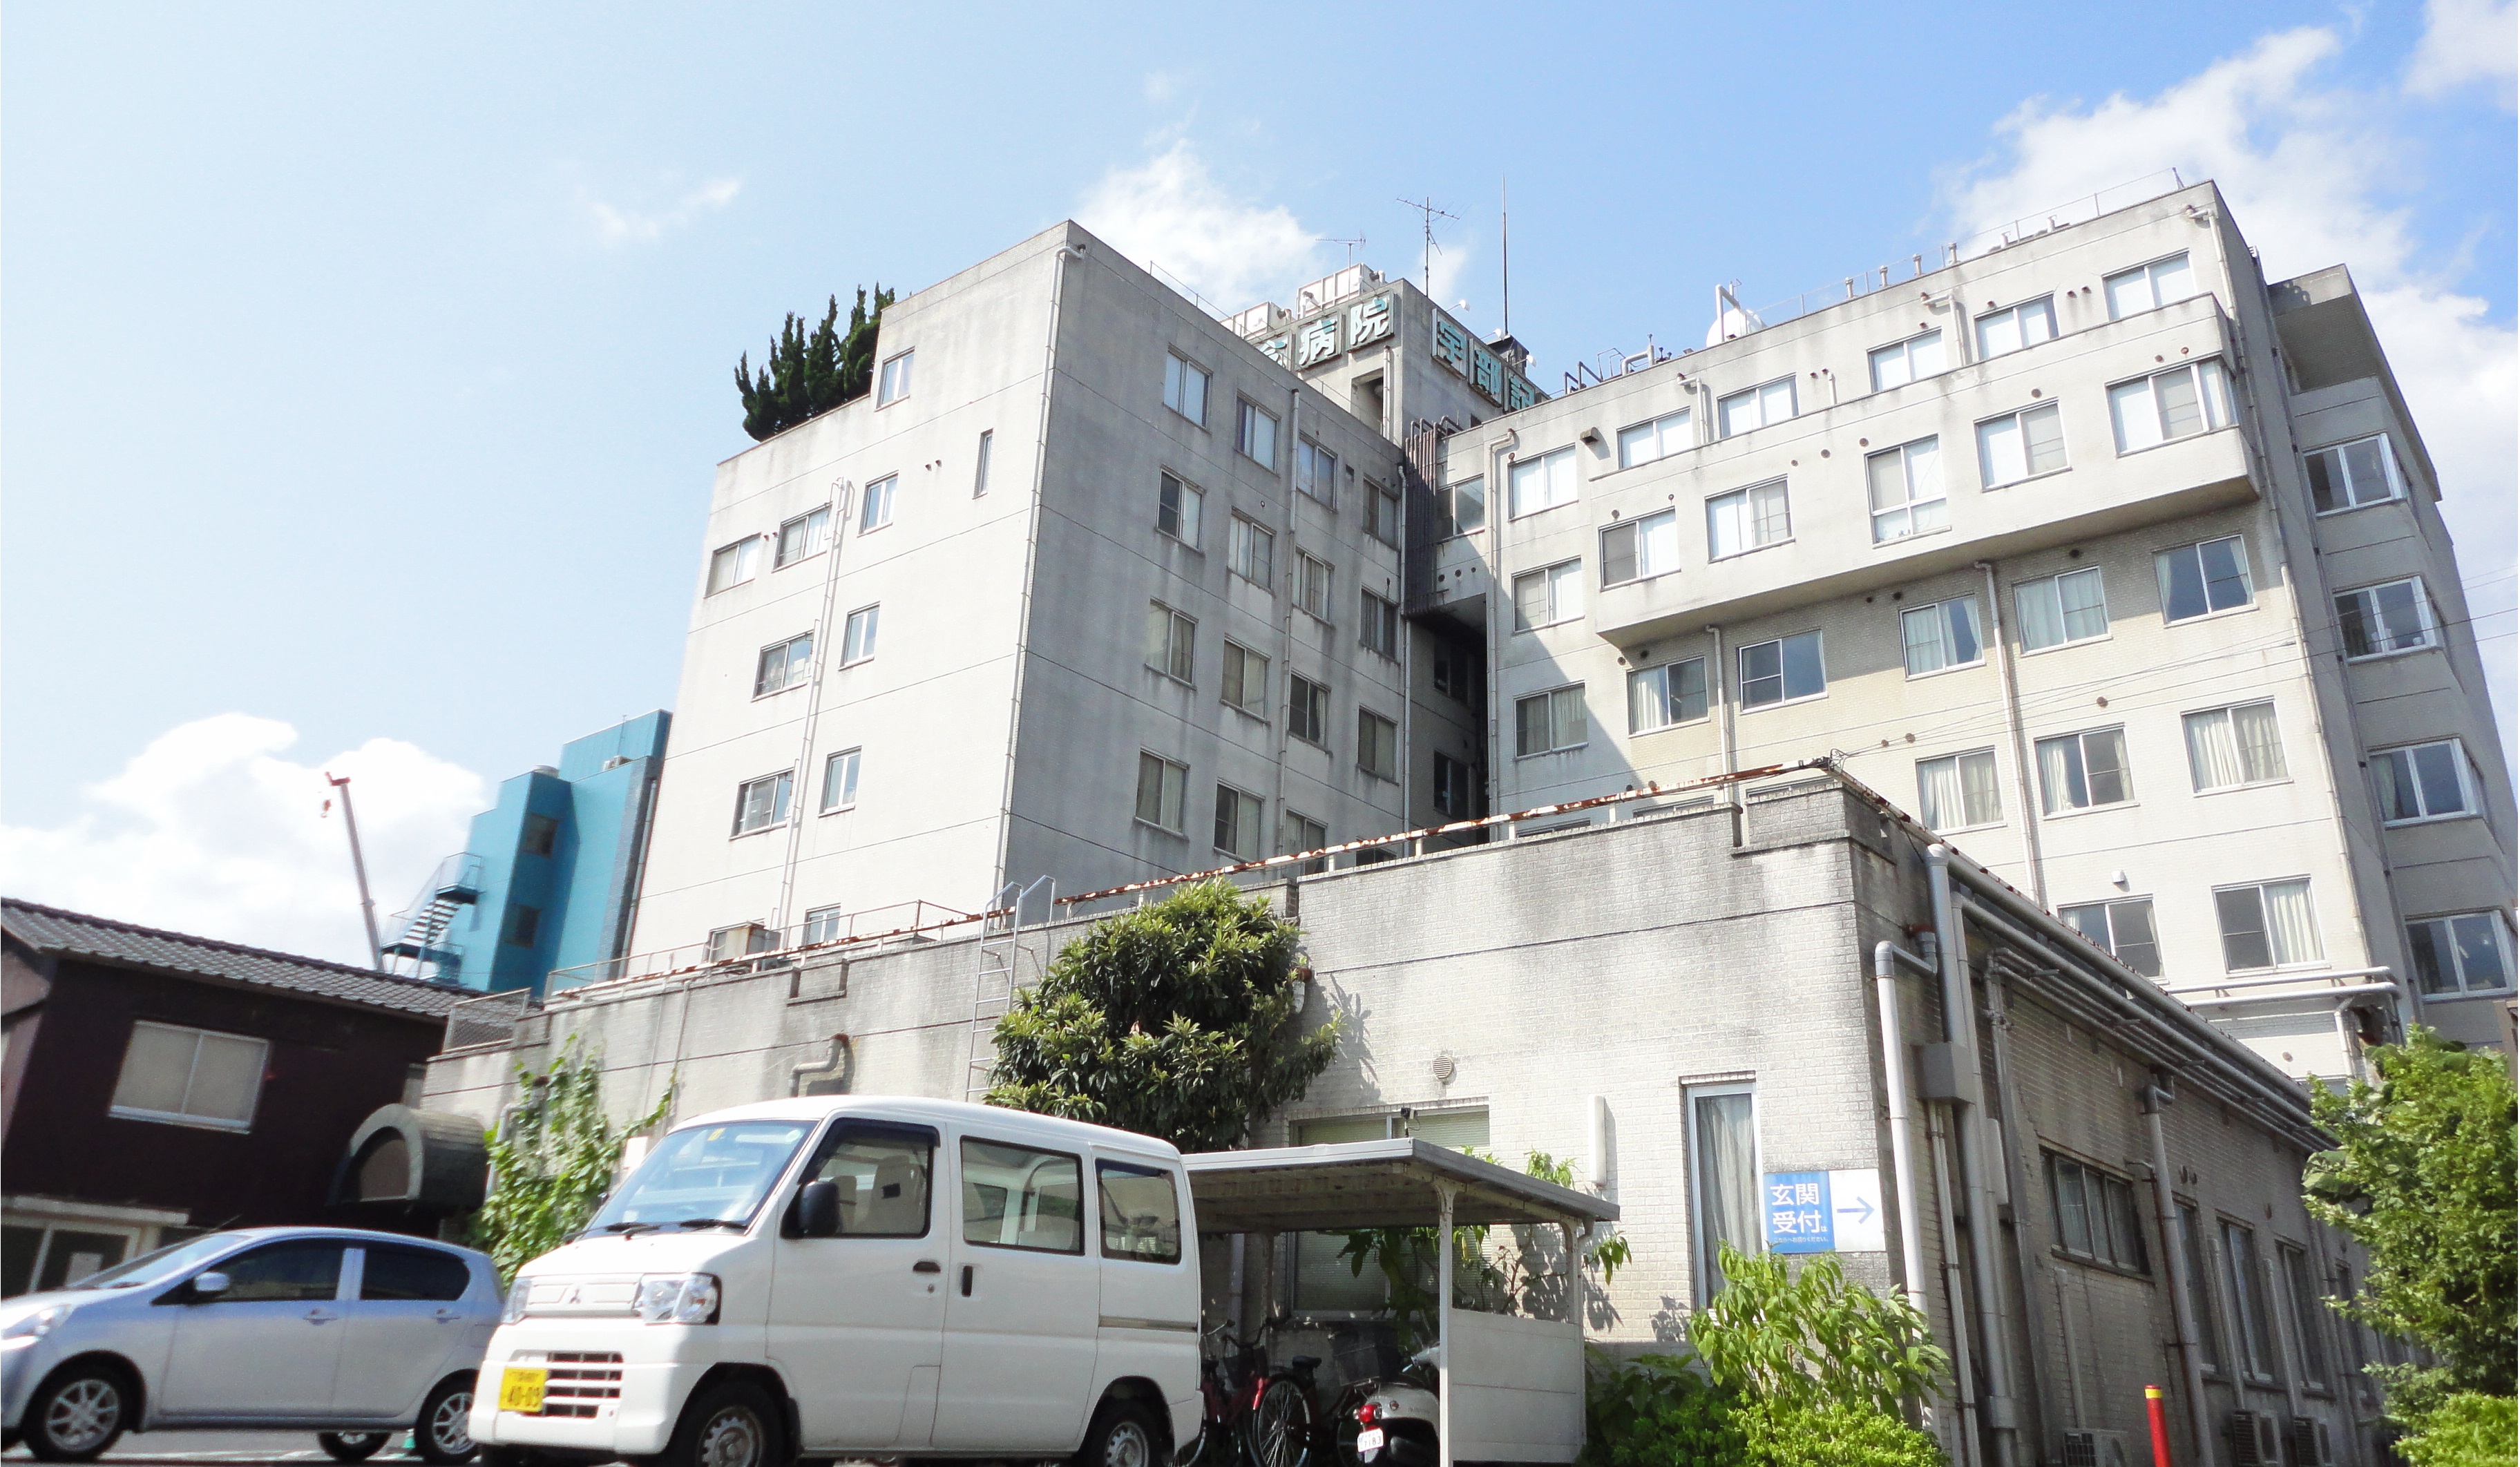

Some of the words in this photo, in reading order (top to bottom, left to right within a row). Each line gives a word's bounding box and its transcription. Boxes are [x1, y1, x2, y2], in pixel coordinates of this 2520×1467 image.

[1769, 1182, 1820, 1206] 玄関
[1772, 1209, 1828, 1234] 受付は
